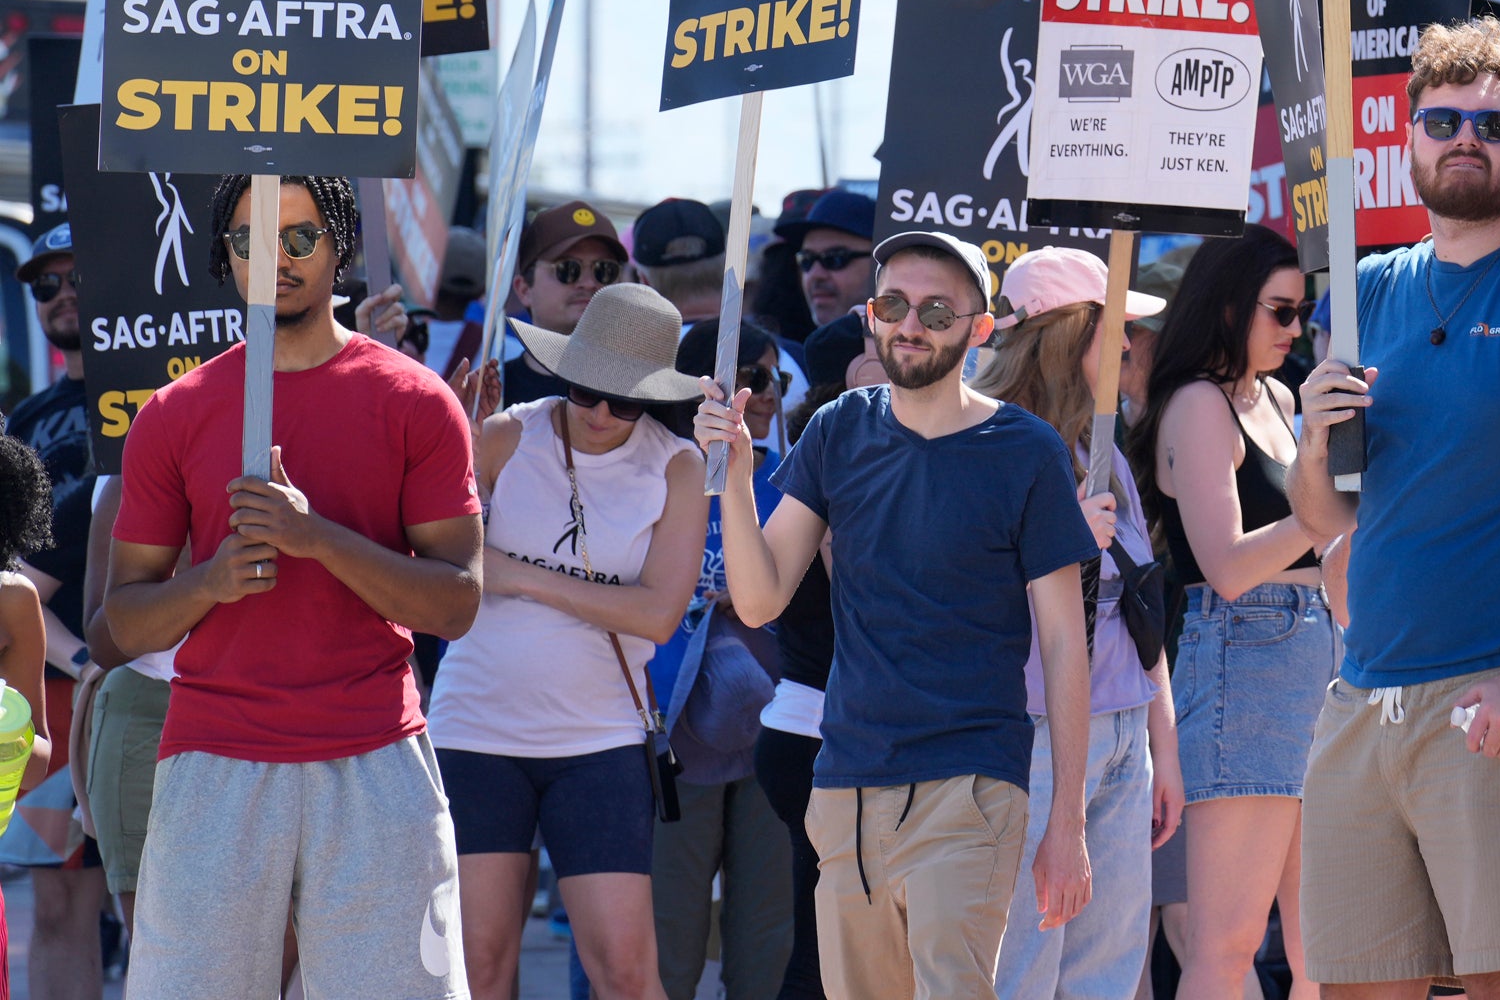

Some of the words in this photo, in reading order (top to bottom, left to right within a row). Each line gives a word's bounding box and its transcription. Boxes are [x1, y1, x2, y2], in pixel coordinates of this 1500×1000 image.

[1351, 25, 1418, 61] MERICA
[232, 47, 288, 76] ON
[1063, 63, 1129, 87] WGA
[1171, 58, 1235, 99] AMPTP
[115, 78, 404, 136] STRIKE!
[1361, 96, 1395, 135] ON
[1070, 117, 1108, 133] WE'RE
[1050, 143, 1129, 159] EVERYTHING.
[1169, 131, 1227, 148] THEY'RE
[1160, 156, 1193, 173] JUST
[1197, 158, 1229, 174] KEN.
[1310, 144, 1324, 171] ON
[1292, 175, 1329, 233] STRI
[981, 239, 1029, 264] ON
[91, 308, 246, 352] SAG·AFTR
